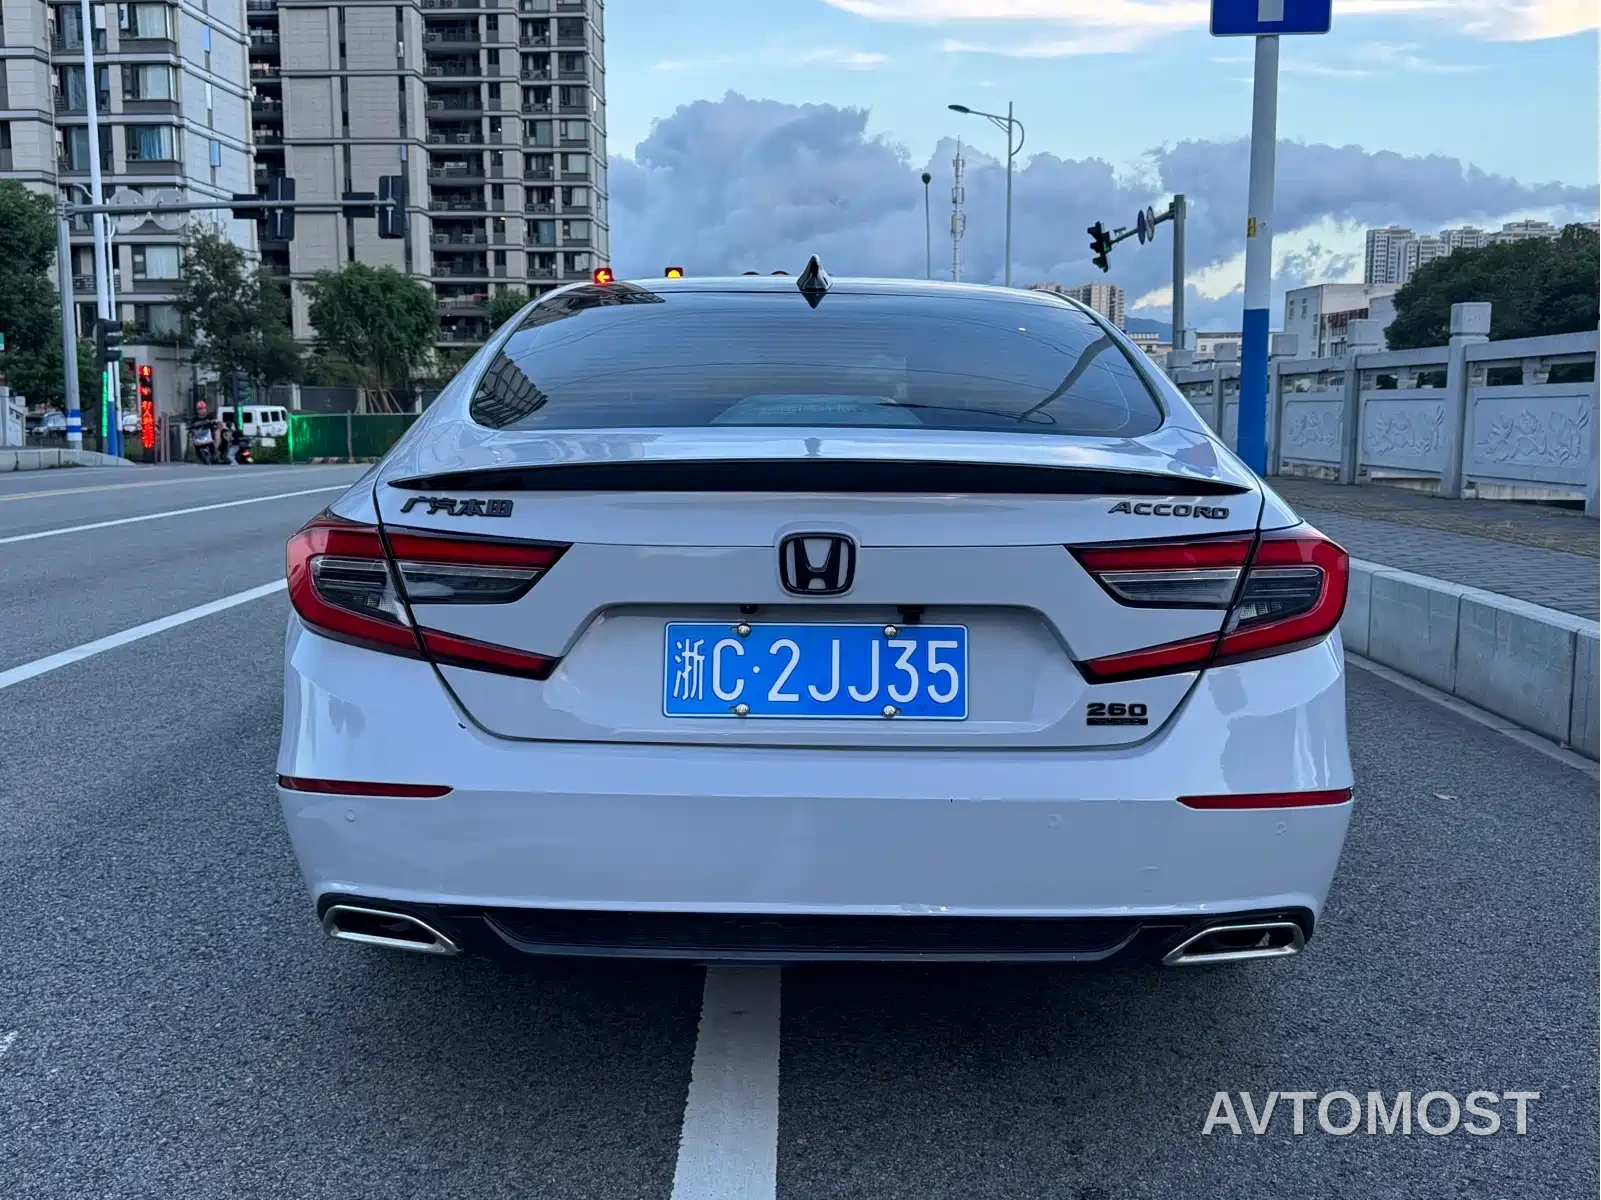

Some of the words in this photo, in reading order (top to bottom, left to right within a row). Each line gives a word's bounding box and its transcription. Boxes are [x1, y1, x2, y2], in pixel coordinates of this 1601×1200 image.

[400, 496, 514, 517] 广汽本田
[1108, 501, 1229, 520] ACCORD
[1086, 702, 1148, 717] 260
